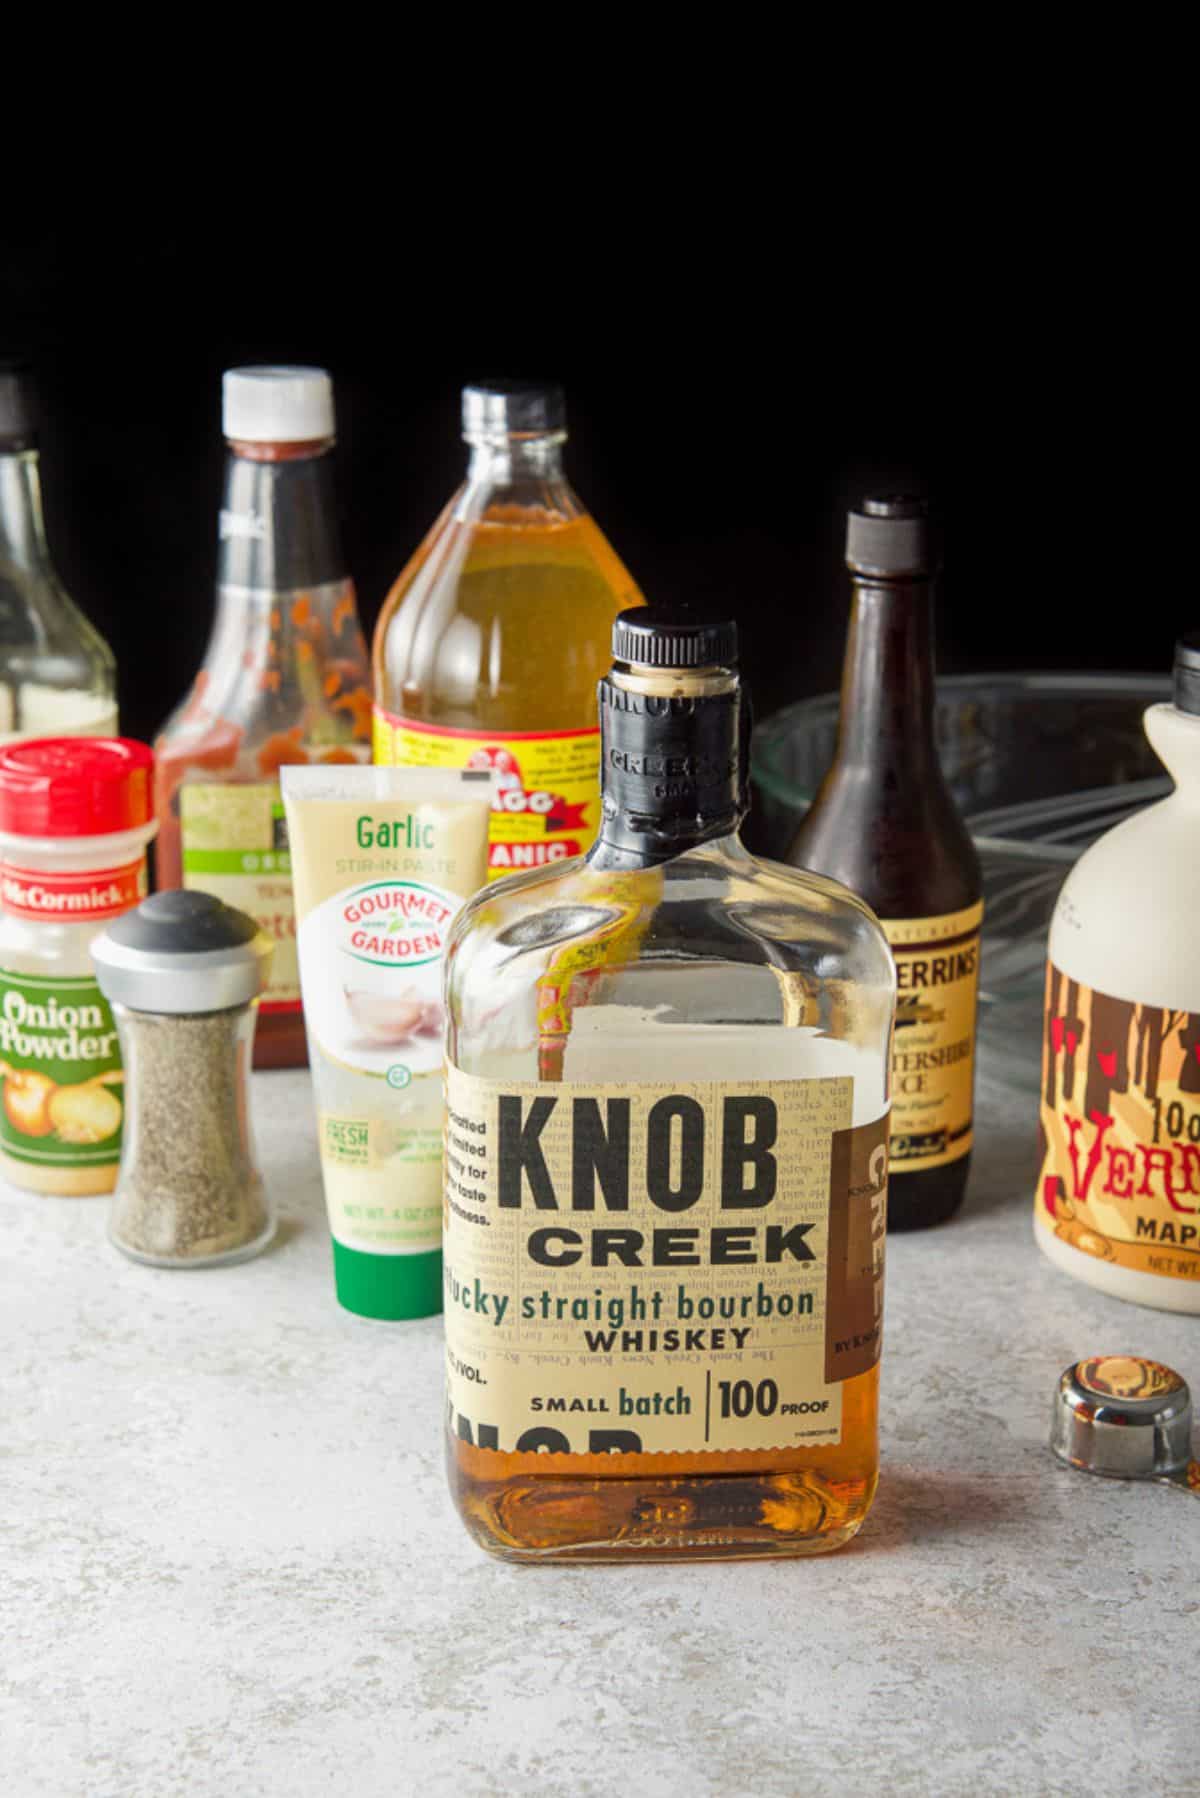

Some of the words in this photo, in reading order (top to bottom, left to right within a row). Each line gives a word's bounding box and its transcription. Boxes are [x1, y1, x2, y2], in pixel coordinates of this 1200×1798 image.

[356, 815, 434, 849] Garlic
[343, 890, 452, 924] GOURMET
[351, 930, 442, 957] GARDEN
[3, 990, 104, 1030] Onion
[0, 1014, 119, 1062] Powder
[499, 1094, 778, 1212] KNOB
[468, 1164, 488, 1180] for
[527, 1223, 817, 1267] CREEK
[521, 1282, 664, 1328] straight
[677, 1280, 814, 1321] bourbon
[584, 1327, 752, 1353] WHISKEY
[530, 1397, 610, 1413] SMALL
[618, 1386, 692, 1417] batch
[717, 1378, 779, 1419] 100
[780, 1399, 830, 1416] PROOF
